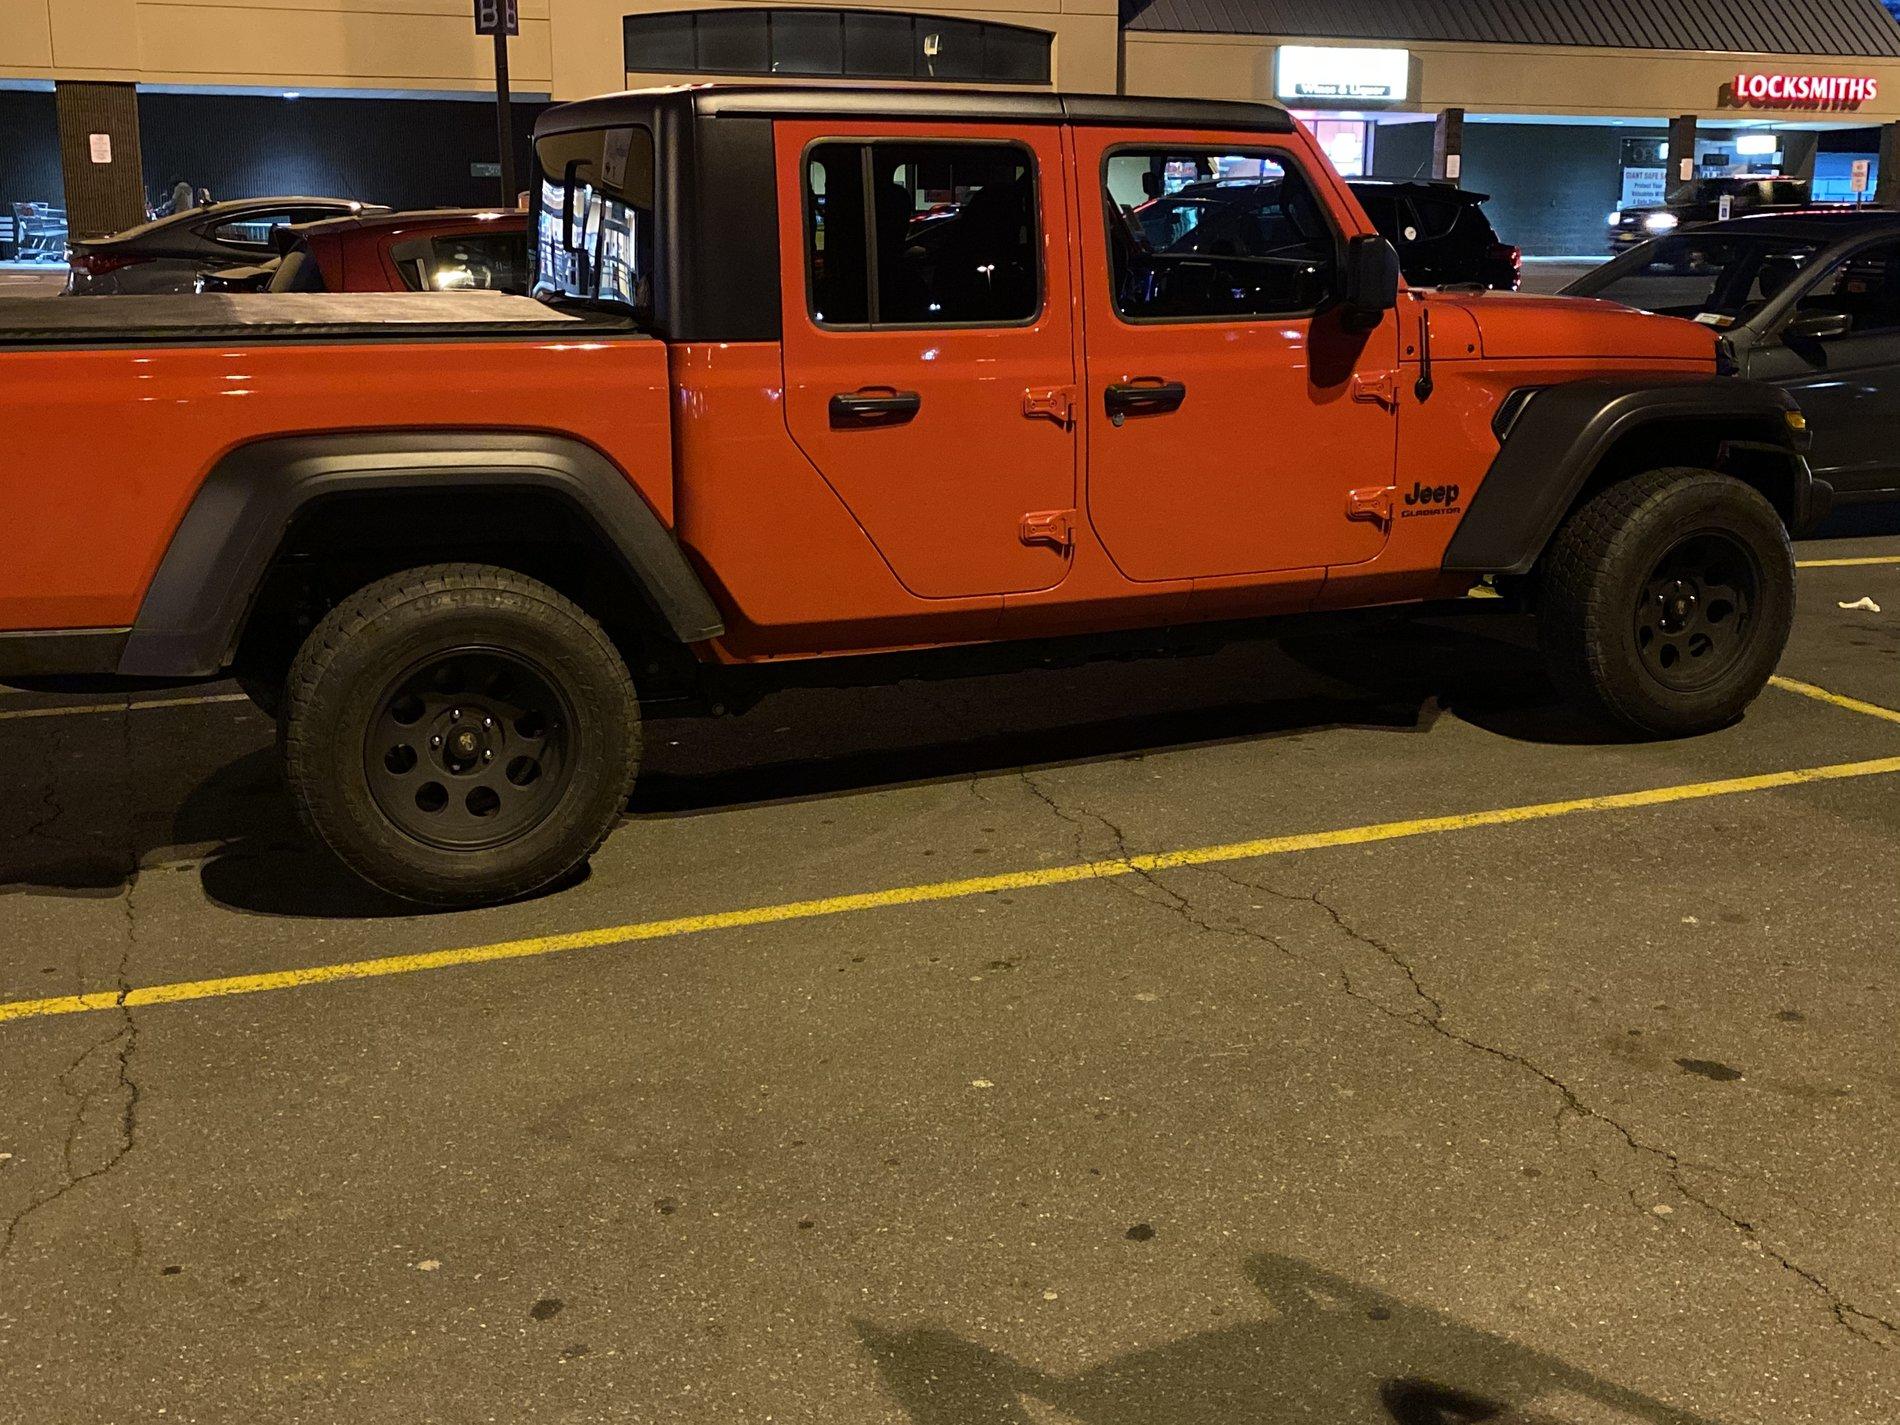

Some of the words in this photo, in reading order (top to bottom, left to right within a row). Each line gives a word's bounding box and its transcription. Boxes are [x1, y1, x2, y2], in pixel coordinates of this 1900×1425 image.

[480, 0, 499, 28] B
[1737, 74, 1877, 100] LOCKSMITHS
[1405, 482, 1460, 507] Jeep
[1401, 507, 1461, 518] GLADIATOR
